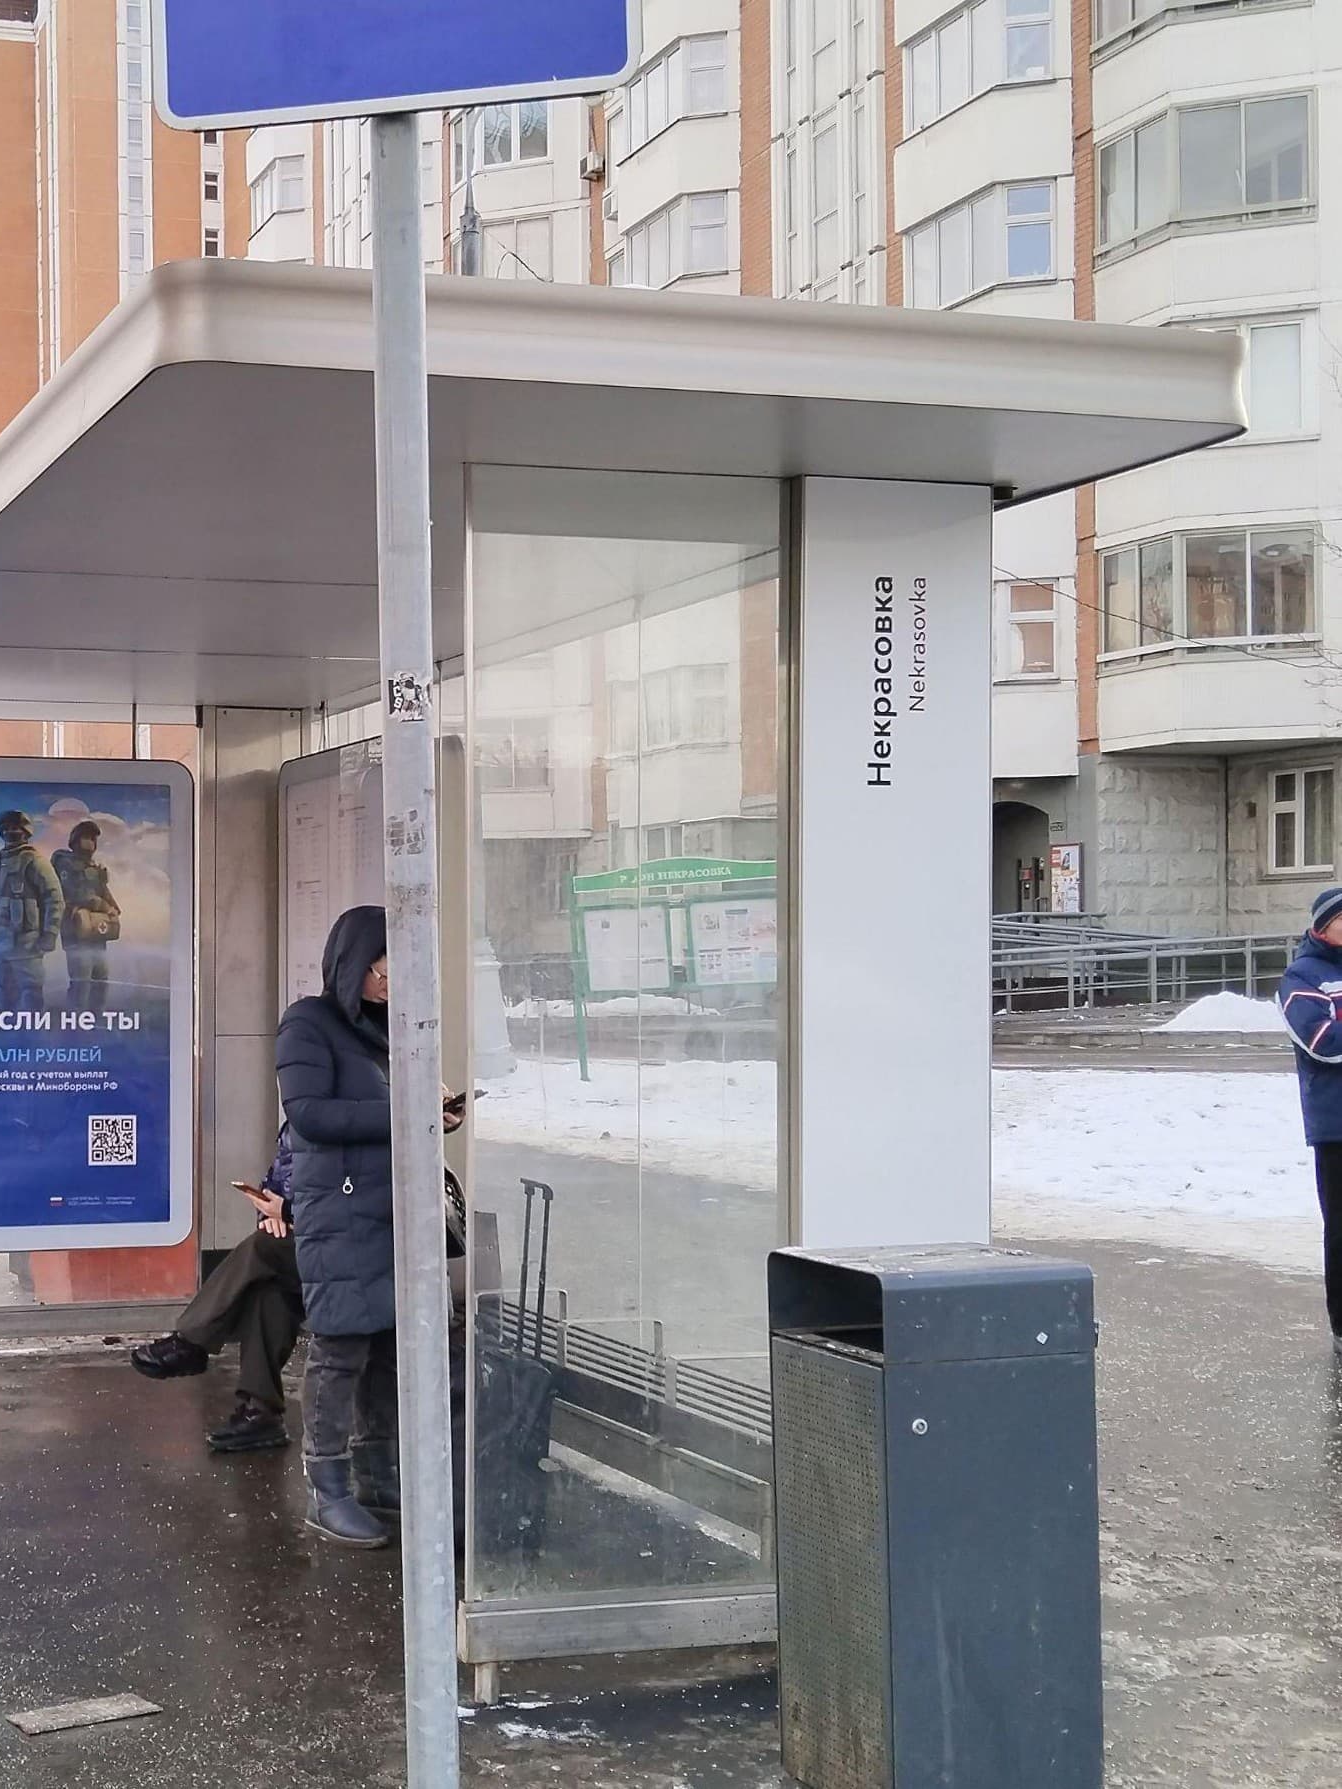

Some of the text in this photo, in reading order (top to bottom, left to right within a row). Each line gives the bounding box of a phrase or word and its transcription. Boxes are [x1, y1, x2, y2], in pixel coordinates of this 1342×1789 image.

[908, 577, 926, 711] Nekrasovka
[867, 576, 897, 786] Некрасовка
[658, 866, 731, 881] НЕКРАСОВКА
[61, 1010, 96, 1030] не
[102, 1010, 140, 1031] ты
[35, 1045, 101, 1063] РУБЛЕЙ
[11, 1071, 28, 1080] год
[29, 1071, 36, 1079] с
[37, 1071, 72, 1080] учетом
[73, 1071, 109, 1079] выплат
[27, 1083, 34, 1091] и
[35, 1081, 101, 1092] Минобороны
[103, 1081, 118, 1090] РФ
